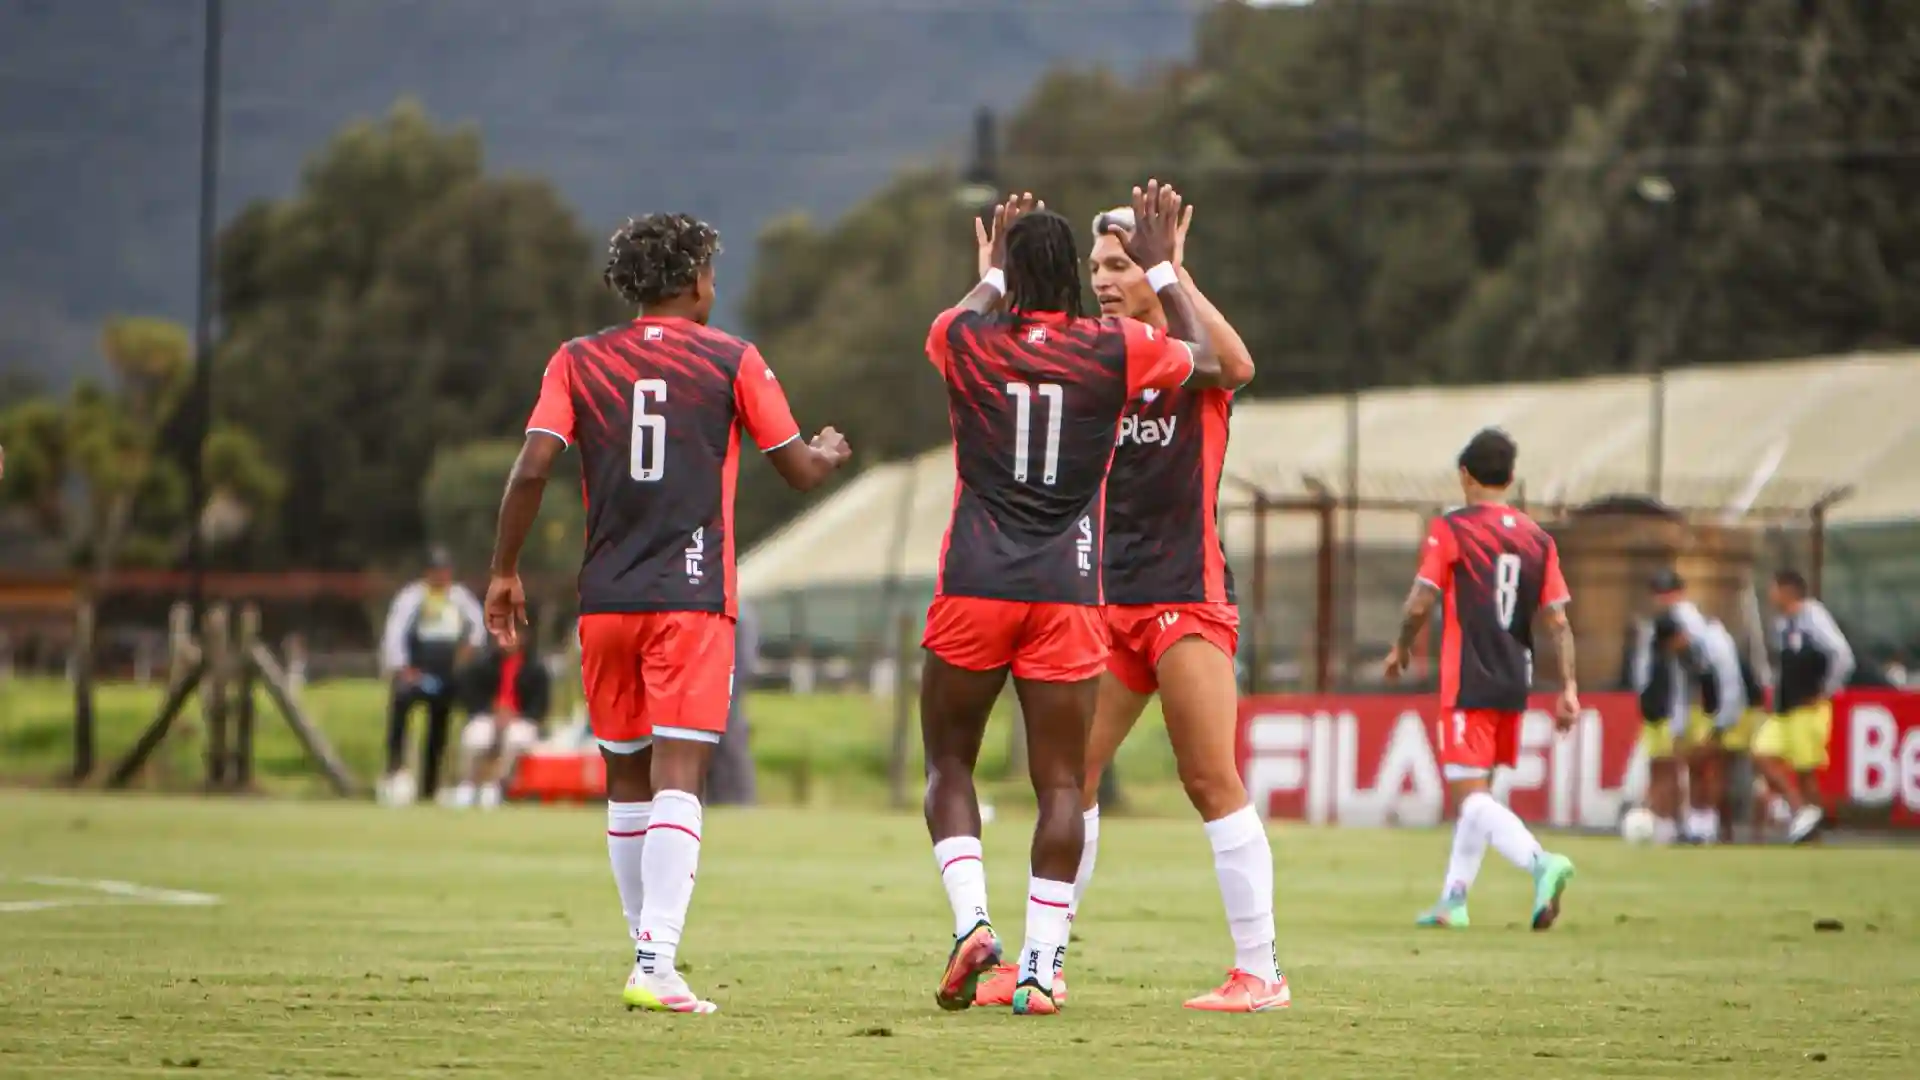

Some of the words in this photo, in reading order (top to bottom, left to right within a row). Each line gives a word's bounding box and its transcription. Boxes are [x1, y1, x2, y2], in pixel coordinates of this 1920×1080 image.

[630, 378, 667, 481] 6
[1006, 382, 1063, 485] 11
[685, 526, 703, 576] FILA
[1076, 515, 1092, 570] FILA
[1496, 553, 1521, 632] 8
[1245, 710, 1444, 827] FILA
